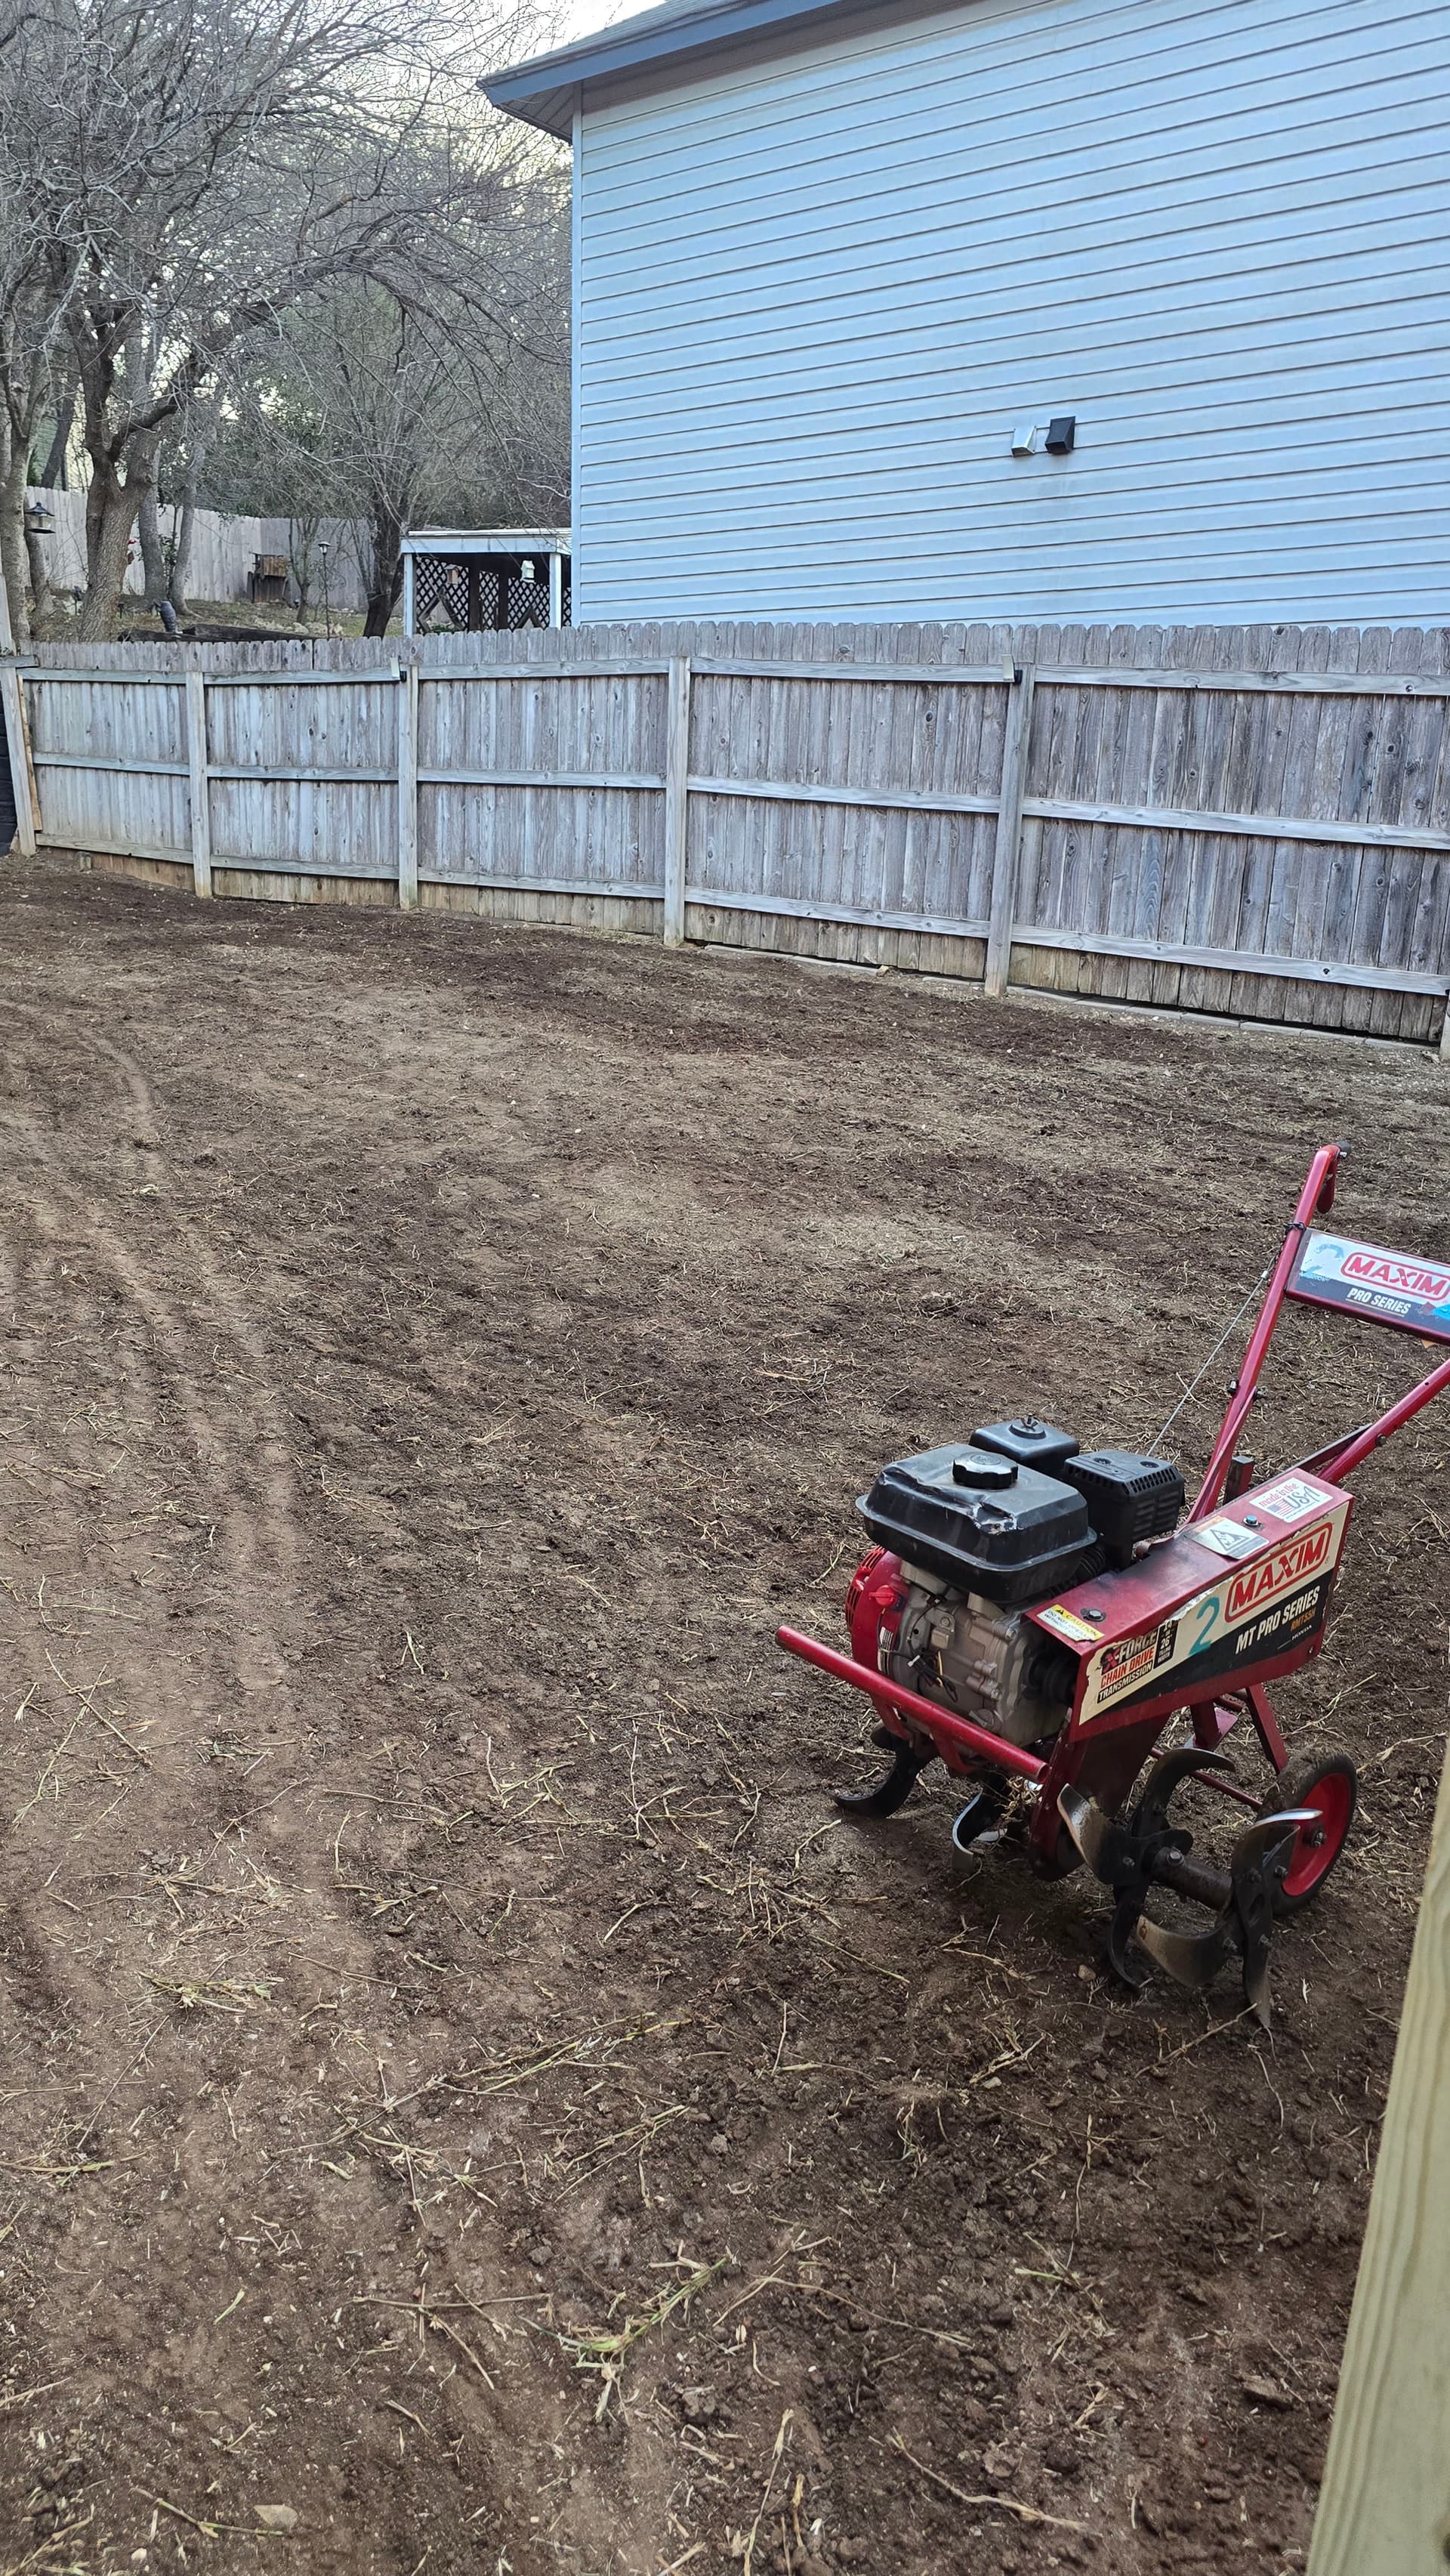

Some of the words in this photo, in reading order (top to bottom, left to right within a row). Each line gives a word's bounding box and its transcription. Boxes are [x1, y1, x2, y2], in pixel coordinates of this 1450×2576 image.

[1348, 1256, 1447, 1296] MAXIM
[1347, 1287, 1372, 1303] PRO
[1371, 1294, 1411, 1314] SERIES
[1259, 1490, 1282, 1507] made
[1285, 1483, 1300, 1494] the
[1284, 1486, 1320, 1509] USA
[1232, 1531, 1326, 1612] MAXIM
[1066, 1614, 1098, 1636] CAUTION
[1188, 1595, 1220, 1657] 2
[1235, 1625, 1257, 1654] MT
[1257, 1610, 1282, 1641] PRO
[1282, 1586, 1320, 1625] SERIES
[1098, 1662, 1152, 1701] TRANSMISSION
[1100, 1663, 1128, 1689] CHAIN
[1128, 1646, 1155, 1673] DRIVE
